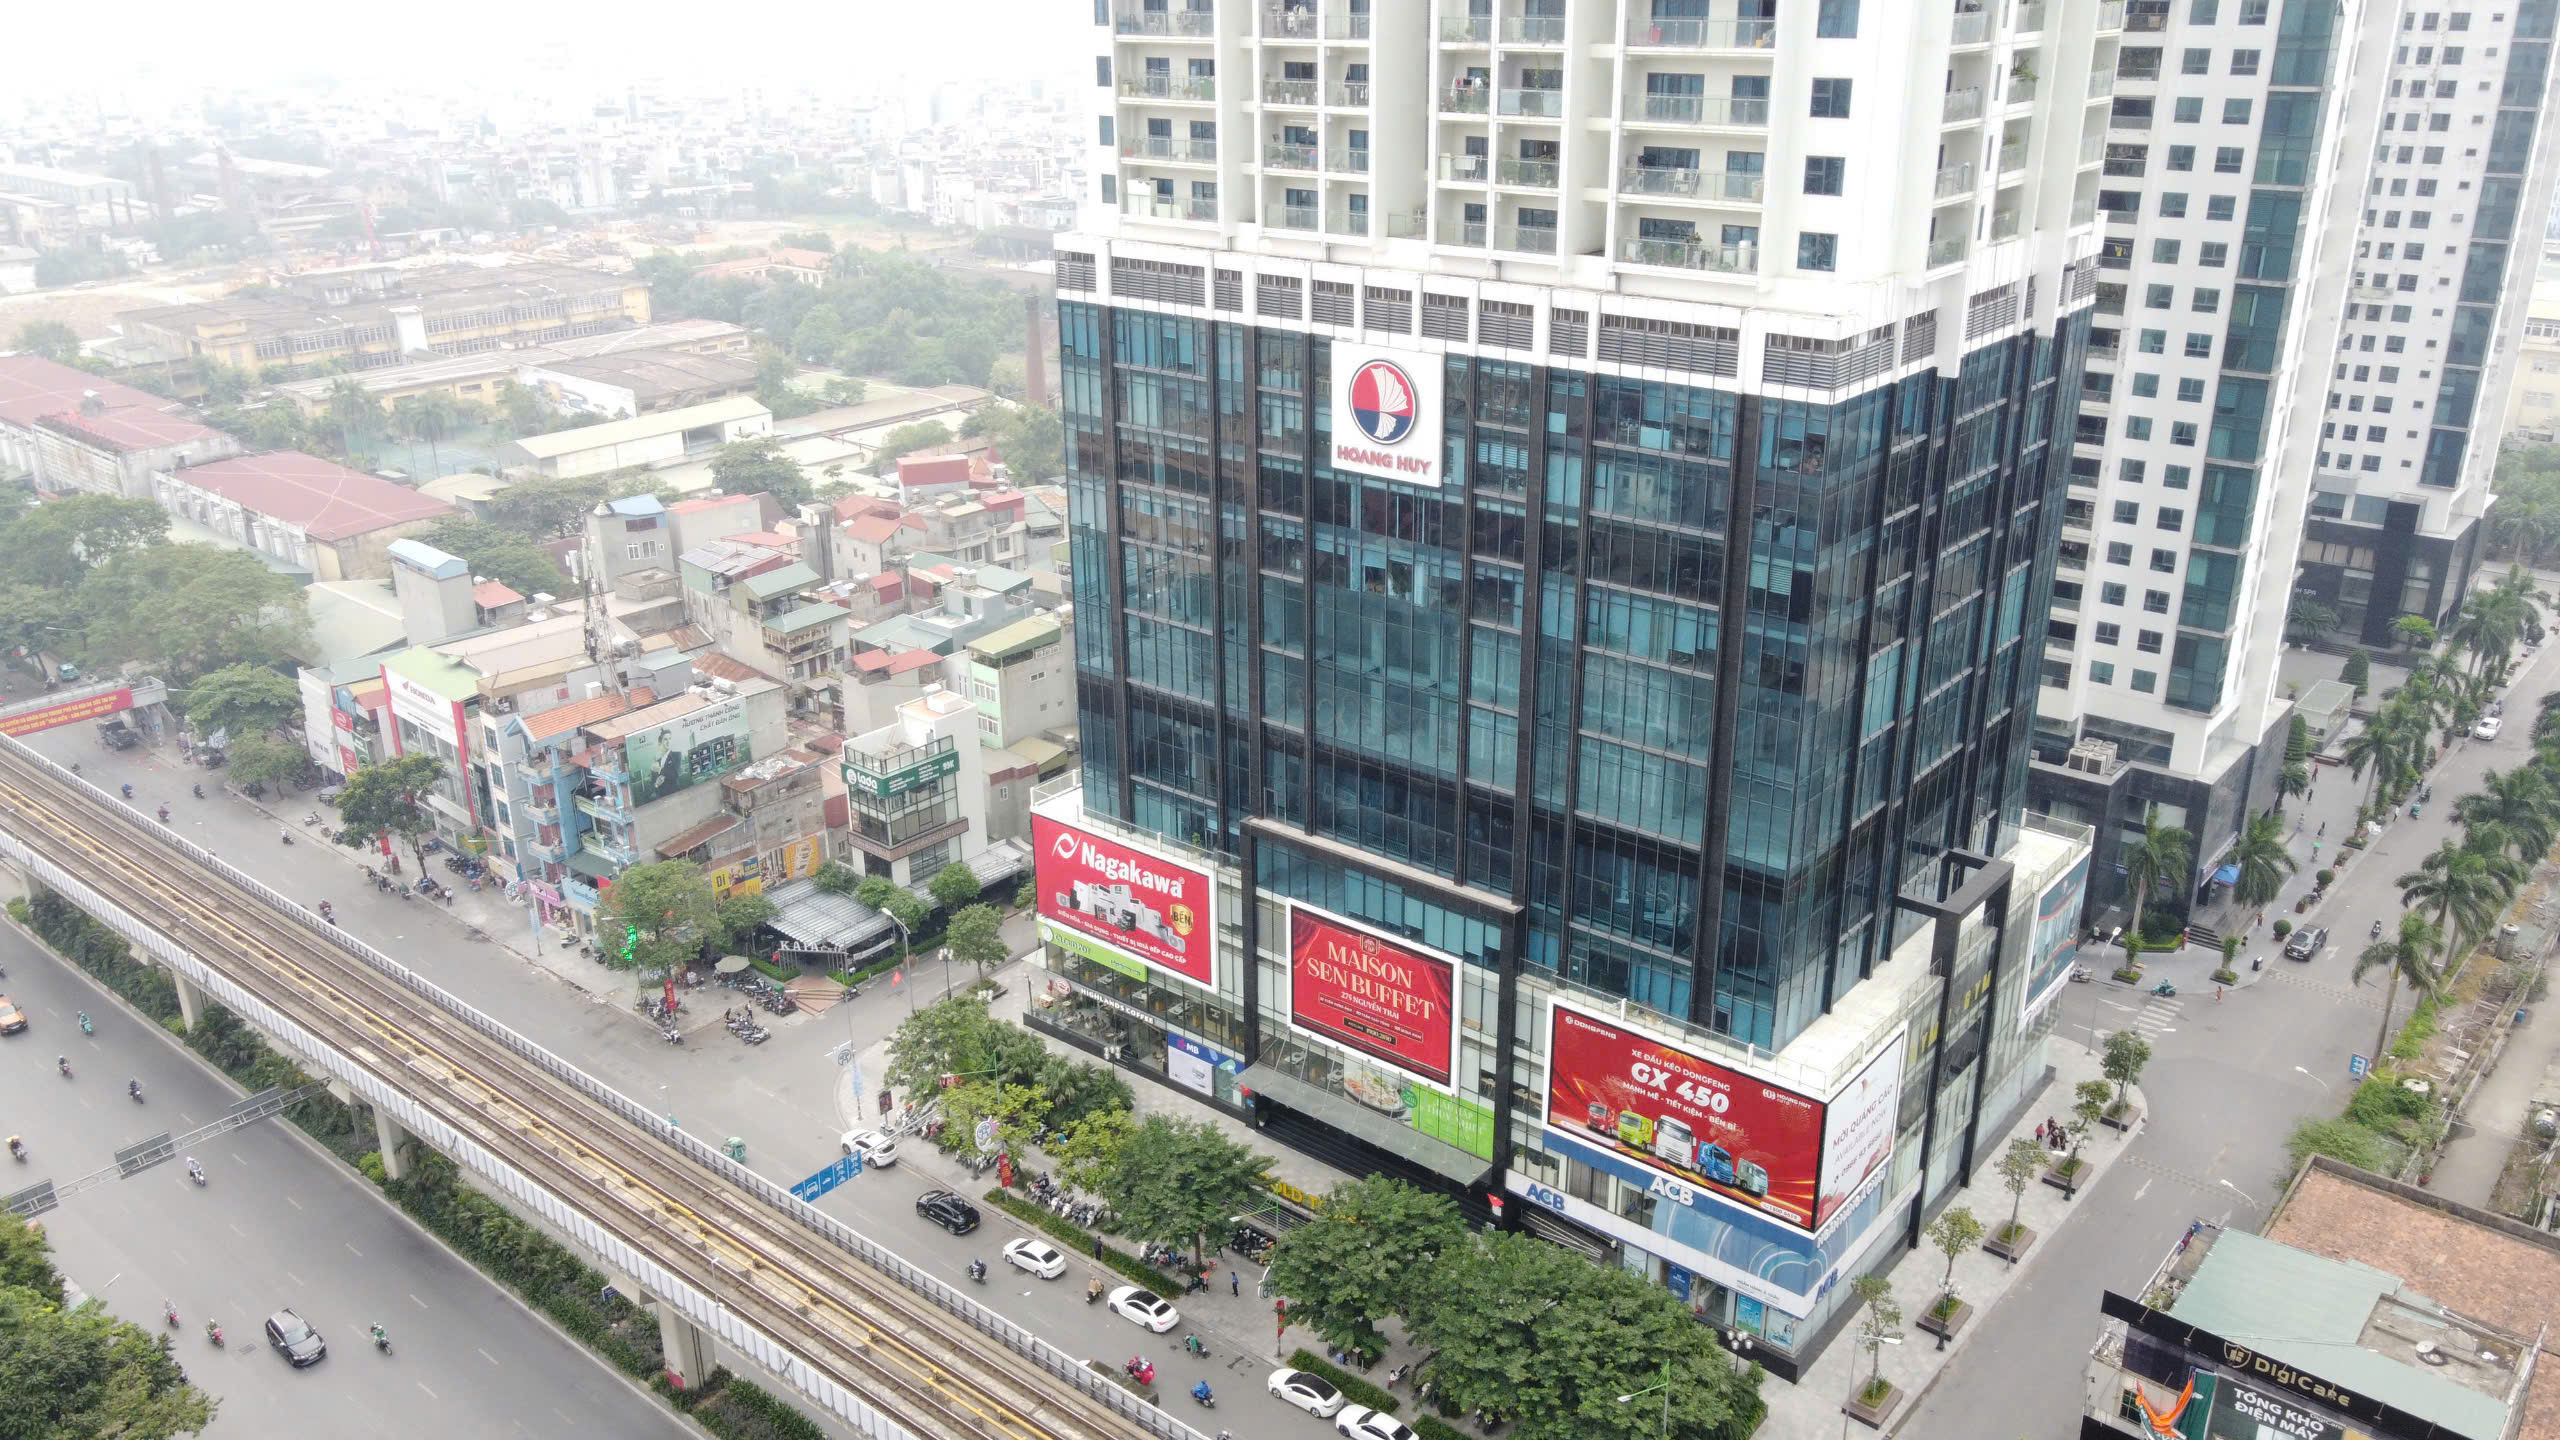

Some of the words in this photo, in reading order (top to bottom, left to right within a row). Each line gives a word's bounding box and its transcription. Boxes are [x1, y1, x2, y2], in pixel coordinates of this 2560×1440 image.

[1337, 445, 1393, 469] HOANG
[1397, 455, 1431, 475] HUY
[1081, 842, 1183, 898] Nagakawa
[1162, 951, 1174, 960] CAO
[1328, 941, 1412, 989] MAISON
[1081, 988, 1125, 1012] HIGHLANDS
[1126, 1007, 1154, 1024] COFFEE
[1307, 958, 1348, 988] SEN
[1351, 973, 1435, 1019] BUFFET
[1574, 1019, 1616, 1039] DONGFENG
[1186, 1043, 1199, 1055] MB
[1631, 1049, 1642, 1059] XE
[1664, 1058, 1681, 1073] KÉO
[1682, 1068, 1730, 1092] DONGFENG
[1631, 1062, 1671, 1092] GX
[1676, 1082, 1729, 1114] 450
[1683, 1101, 1702, 1118] KIỆM
[1777, 1093, 1798, 1104] HOANG
[1799, 1100, 1811, 1109] HUY
[1526, 1183, 1565, 1211] ACB
[1649, 1176, 1694, 1206] ACB
[1816, 1267, 1838, 1304] ACB
[2234, 1387, 2282, 1415] TỔNG
[2285, 1409, 2324, 1432] KHO
[2234, 1401, 2276, 1424] ĐIỆN
[2279, 1418, 2318, 1440] MÁY
